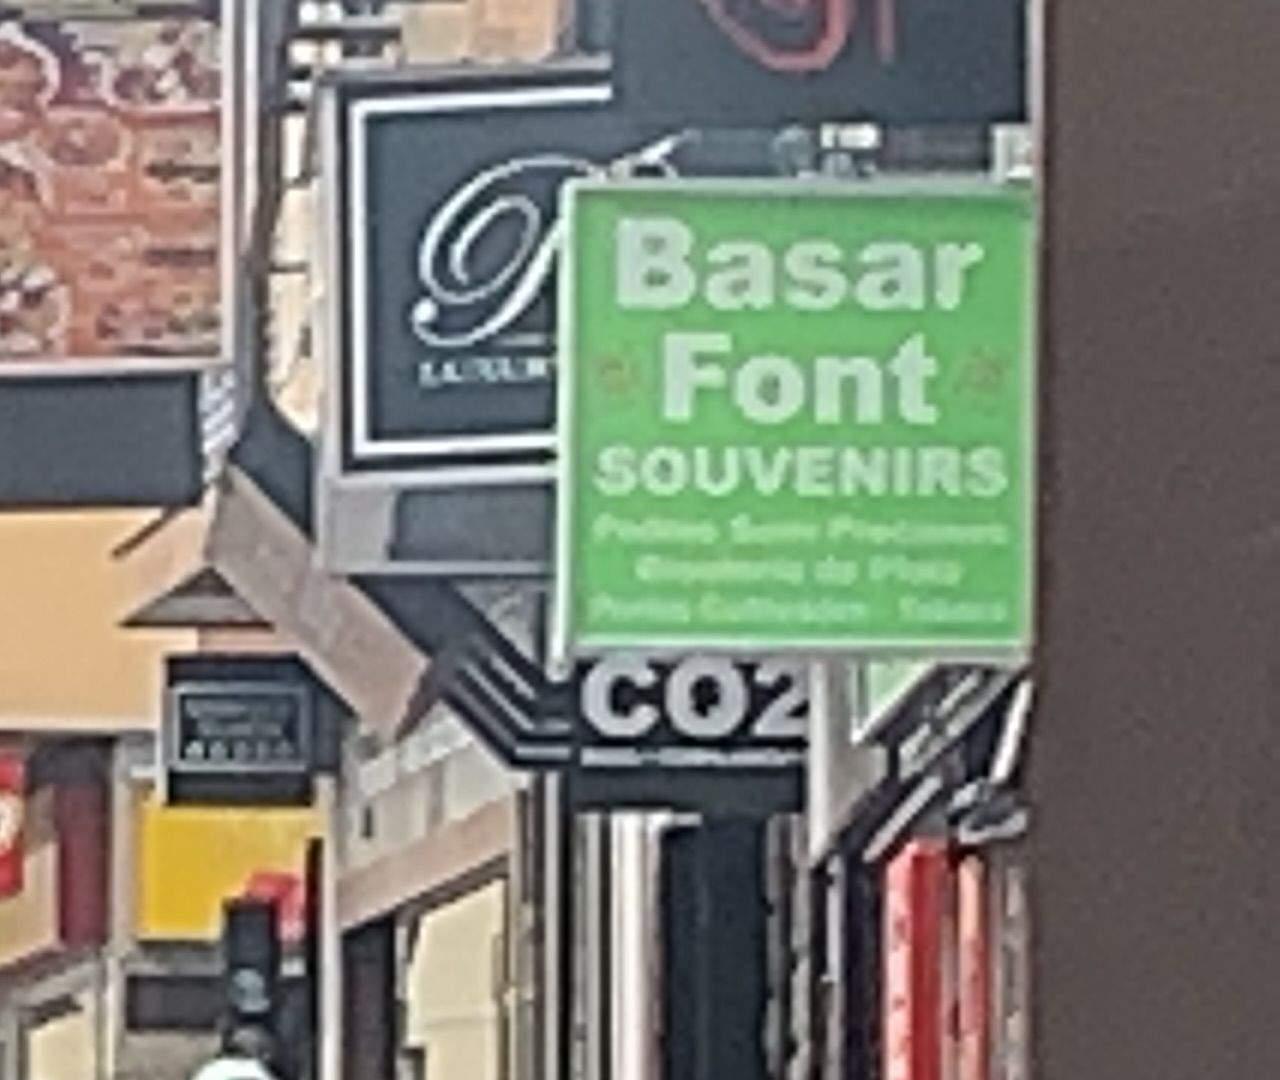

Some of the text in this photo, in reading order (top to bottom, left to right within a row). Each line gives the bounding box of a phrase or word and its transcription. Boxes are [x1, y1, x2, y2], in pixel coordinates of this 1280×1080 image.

[614, 214, 984, 312] Basar
[661, 330, 941, 426] Font
[592, 443, 1010, 499] SOUVENIRS
[580, 654, 811, 739] CO2
